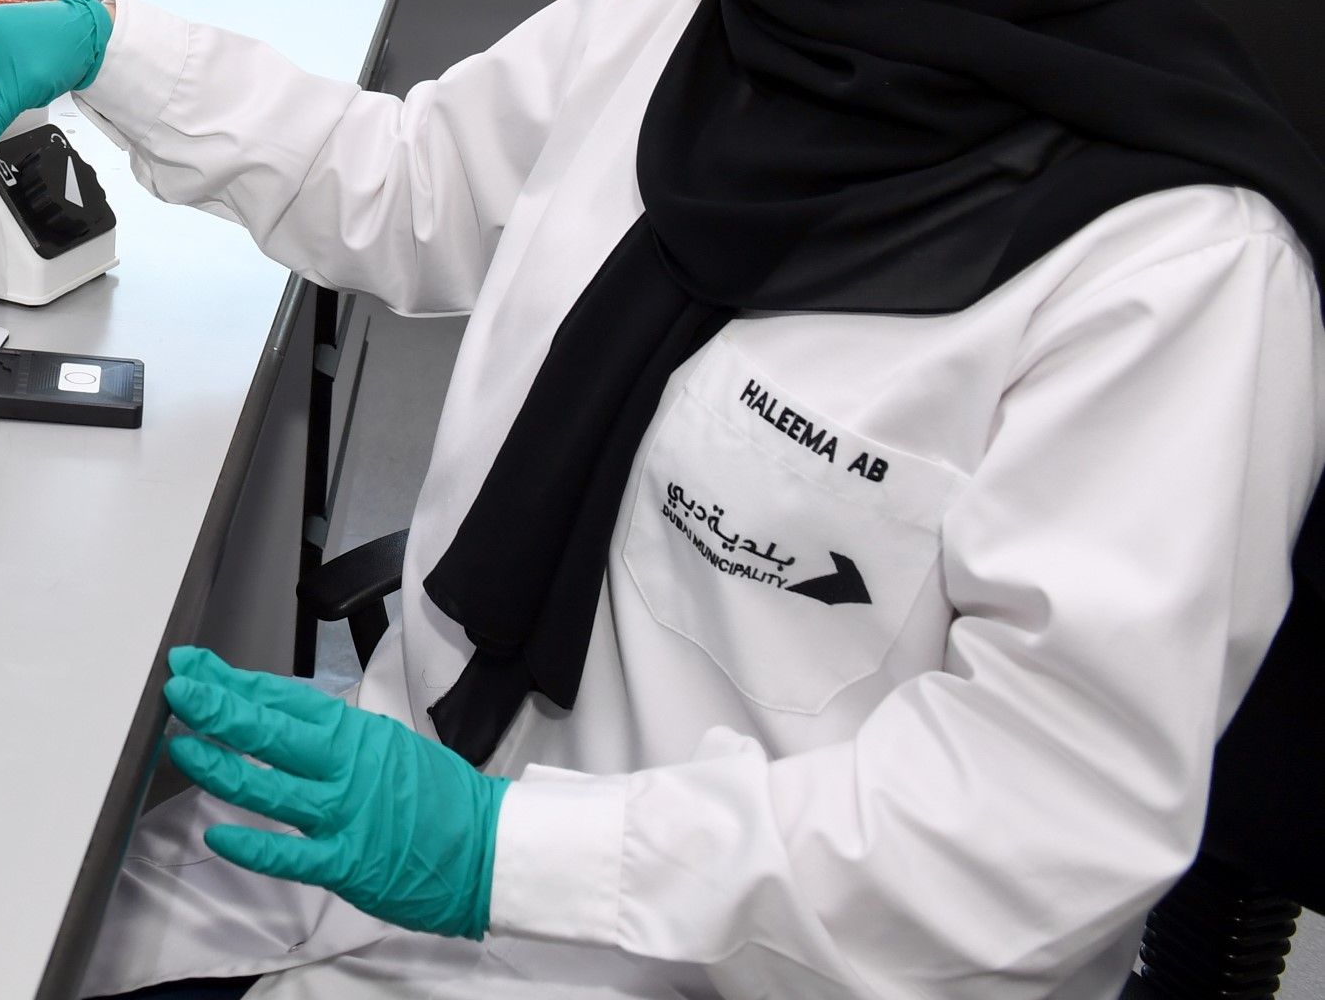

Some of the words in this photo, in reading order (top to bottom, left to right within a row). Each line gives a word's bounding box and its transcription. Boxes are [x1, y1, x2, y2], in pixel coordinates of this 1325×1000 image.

[739, 379, 838, 463] HALEEMA
[847, 452, 889, 483] AB
[667, 481, 708, 521] دبي
[707, 504, 796, 572] بلدية
[662, 504, 692, 541] DUBAI
[692, 534, 788, 589] MUNICIPALITY
